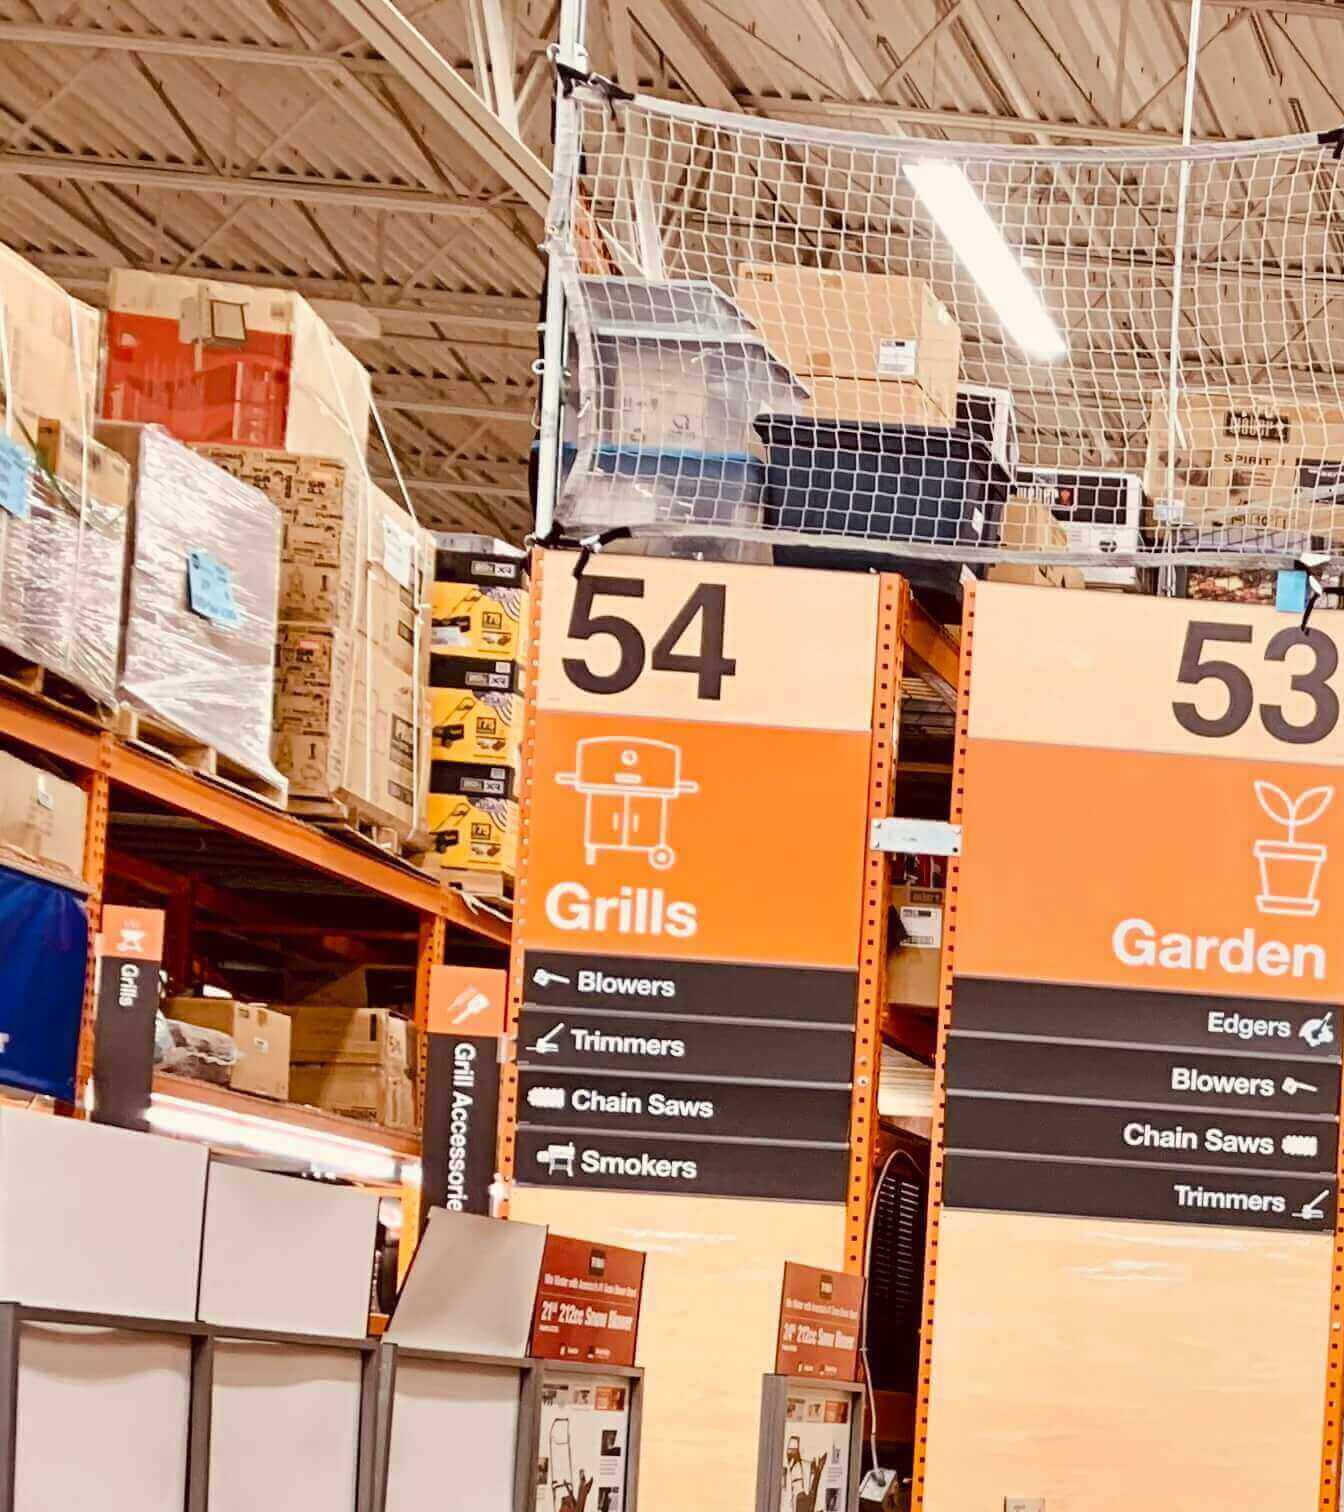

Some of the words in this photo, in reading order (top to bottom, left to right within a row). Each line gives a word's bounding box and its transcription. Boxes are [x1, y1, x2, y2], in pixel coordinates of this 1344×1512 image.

[561, 575, 737, 700] 54
[1172, 619, 1341, 744] 53
[545, 882, 697, 937] Grills
[1112, 920, 1325, 979] Garden
[120, 963, 140, 1007] Grills
[577, 970, 676, 997] Blowers
[1208, 1012, 1290, 1039] Edgers
[571, 1031, 685, 1058] Trimmers
[454, 1042, 476, 1088] Grill
[1171, 1068, 1274, 1097] Blowers
[571, 1090, 645, 1116] Chain
[648, 1093, 714, 1118] Saws
[447, 1091, 474, 1212] Accessorie
[1123, 1124, 1198, 1152] Chain
[1204, 1127, 1274, 1154] Saws
[581, 1151, 697, 1179] Smokers
[1174, 1185, 1285, 1212] Trimmers
